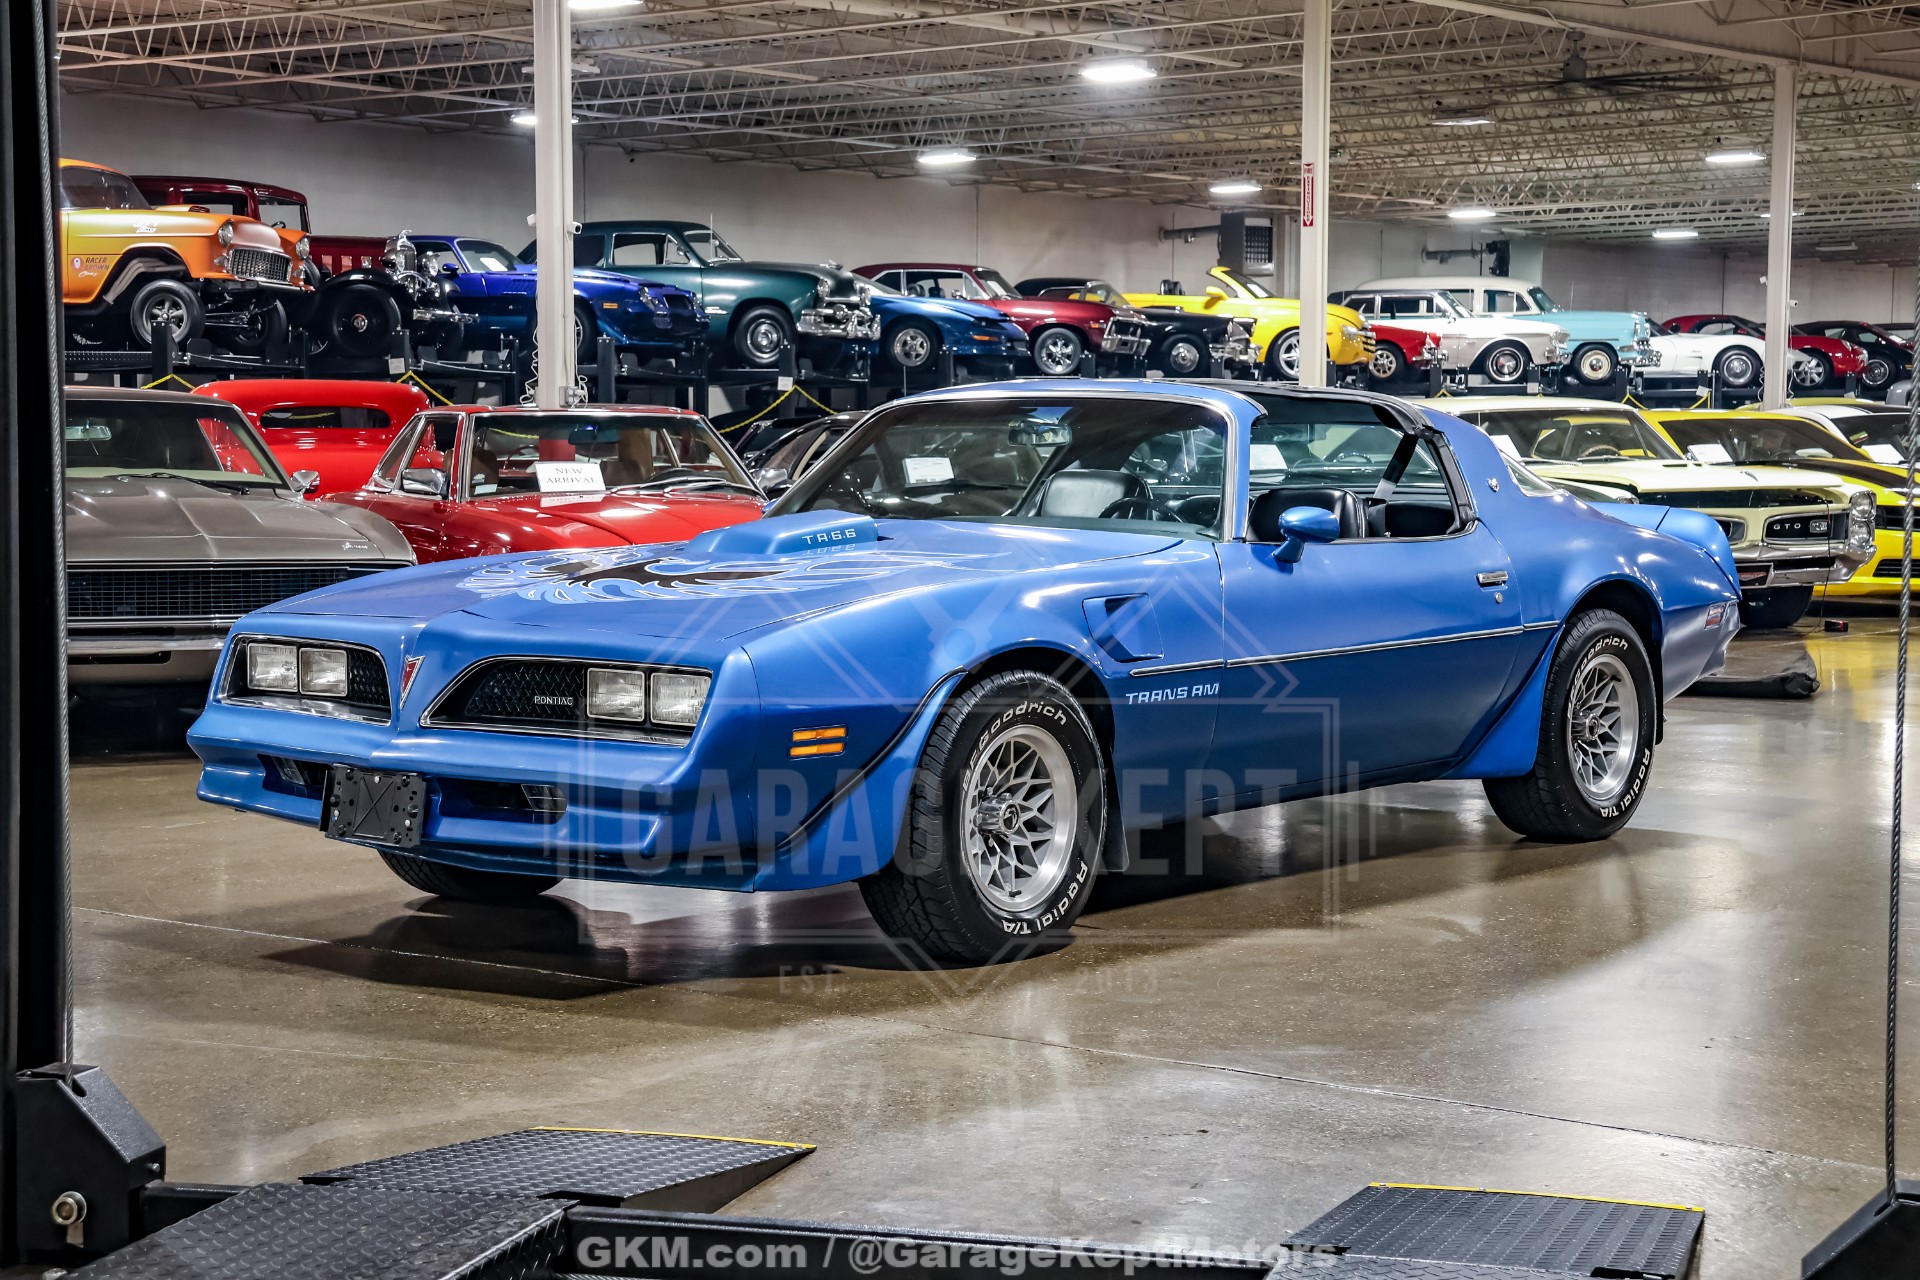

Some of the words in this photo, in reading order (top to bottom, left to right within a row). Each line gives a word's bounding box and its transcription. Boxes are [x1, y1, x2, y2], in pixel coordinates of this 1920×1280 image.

[546, 476, 598, 484] ARRIVAL
[534, 695, 574, 706] PONTIAC
[1125, 686, 1189, 705] TRANS
[1191, 682, 1220, 697] AM
[1619, 747, 1651, 812] Radial
[1599, 805, 1620, 818] T/A
[1036, 860, 1089, 932] Radial
[1001, 919, 1032, 935] T/A
